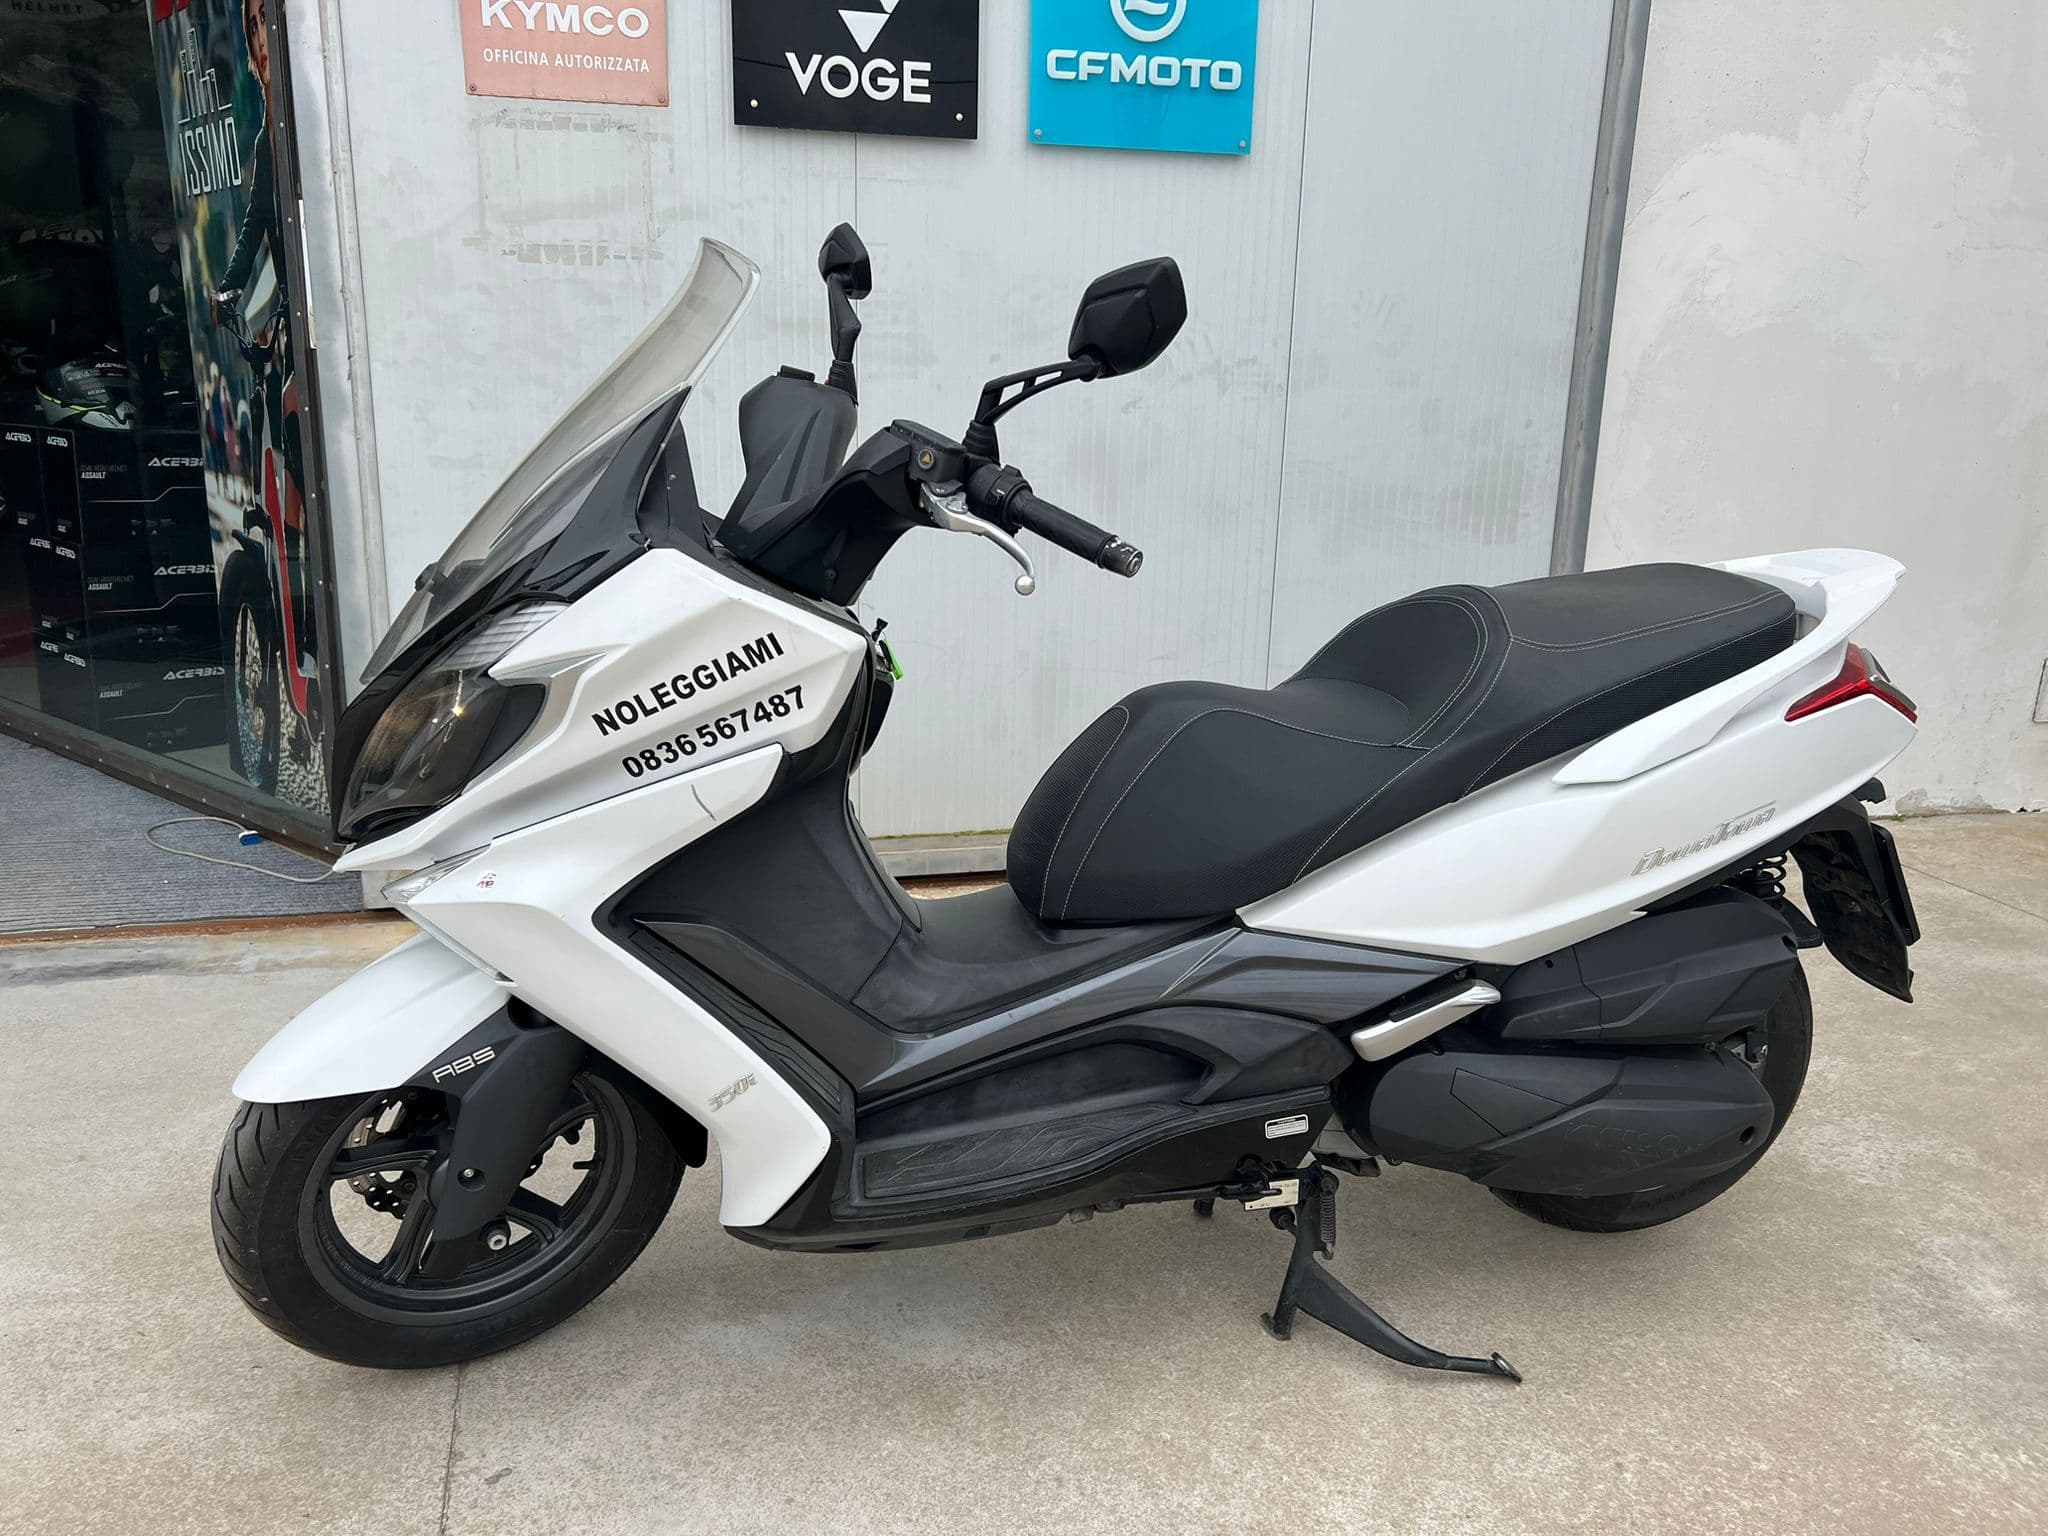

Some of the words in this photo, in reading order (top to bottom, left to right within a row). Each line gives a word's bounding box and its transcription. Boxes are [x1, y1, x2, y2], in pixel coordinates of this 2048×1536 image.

[481, 0, 650, 39] KYMCO
[483, 48, 549, 66] OFFICINA
[555, 53, 650, 73] AUTORIZZATA
[785, 51, 932, 104] VOGE
[1046, 48, 1242, 91] CFMOTO
[179, 116, 242, 197] ISSIMO
[148, 456, 204, 467] ACERBI
[591, 632, 785, 737] NOLEGGIAMI
[621, 733, 697, 778] 0836
[695, 685, 805, 748] 567487
[432, 1046, 497, 1084] ABS
